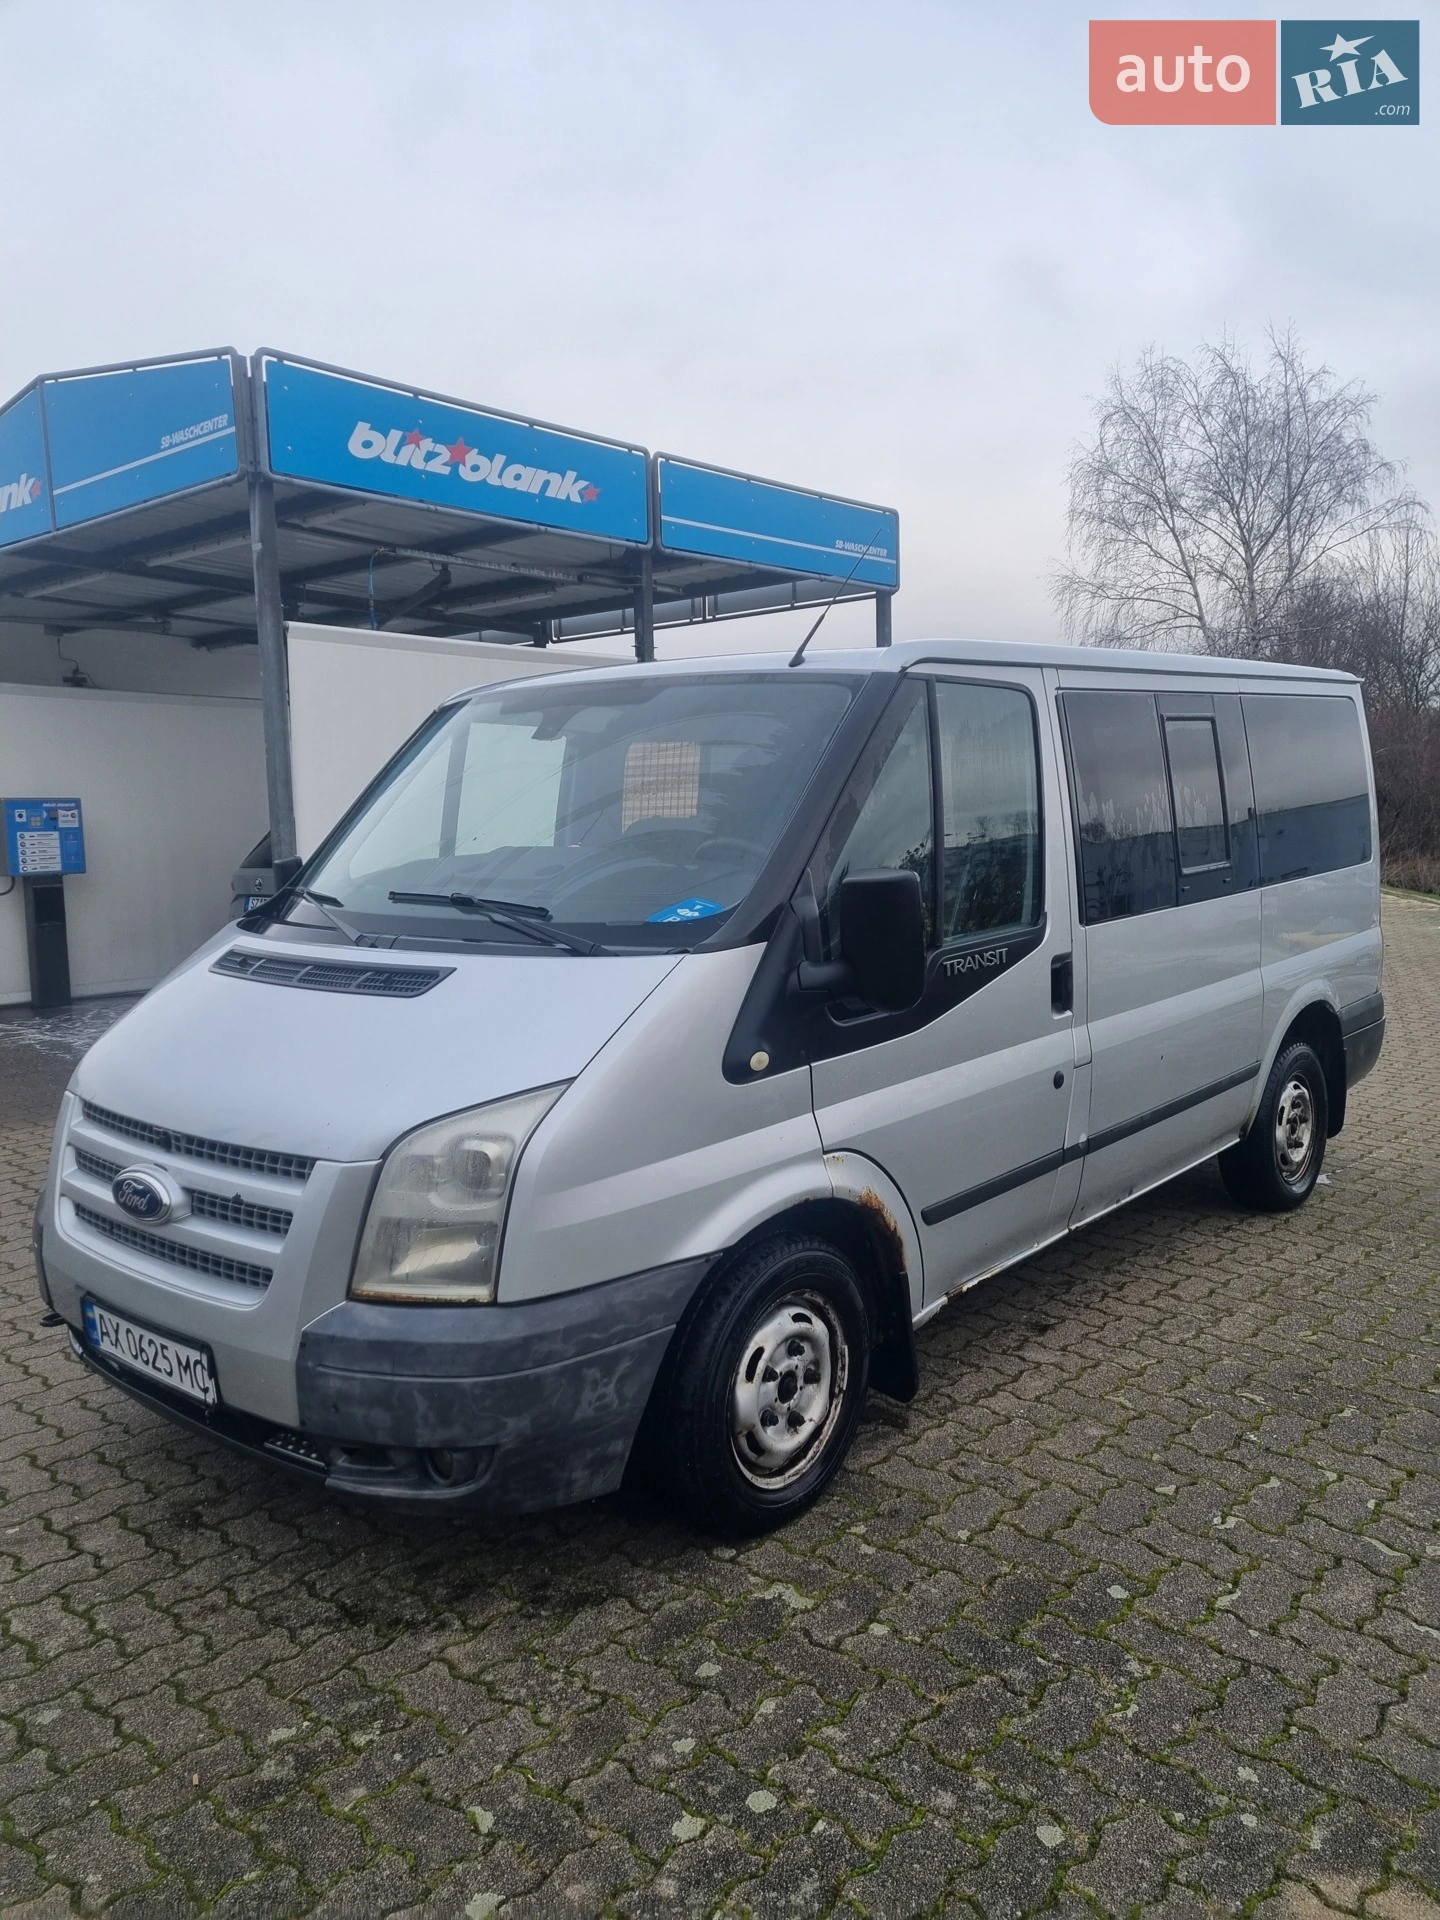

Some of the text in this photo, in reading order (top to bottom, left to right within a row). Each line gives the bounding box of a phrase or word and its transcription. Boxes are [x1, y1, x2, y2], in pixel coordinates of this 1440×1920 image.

[160, 414, 228, 449] SB-WASCHCENTER
[348, 421, 593, 503] blitz blank
[0, 472, 36, 513] nk
[942, 948, 1008, 977] TRANSIT
[118, 1180, 151, 1211] Ford
[98, 1312, 210, 1394] AX 0625 MC
